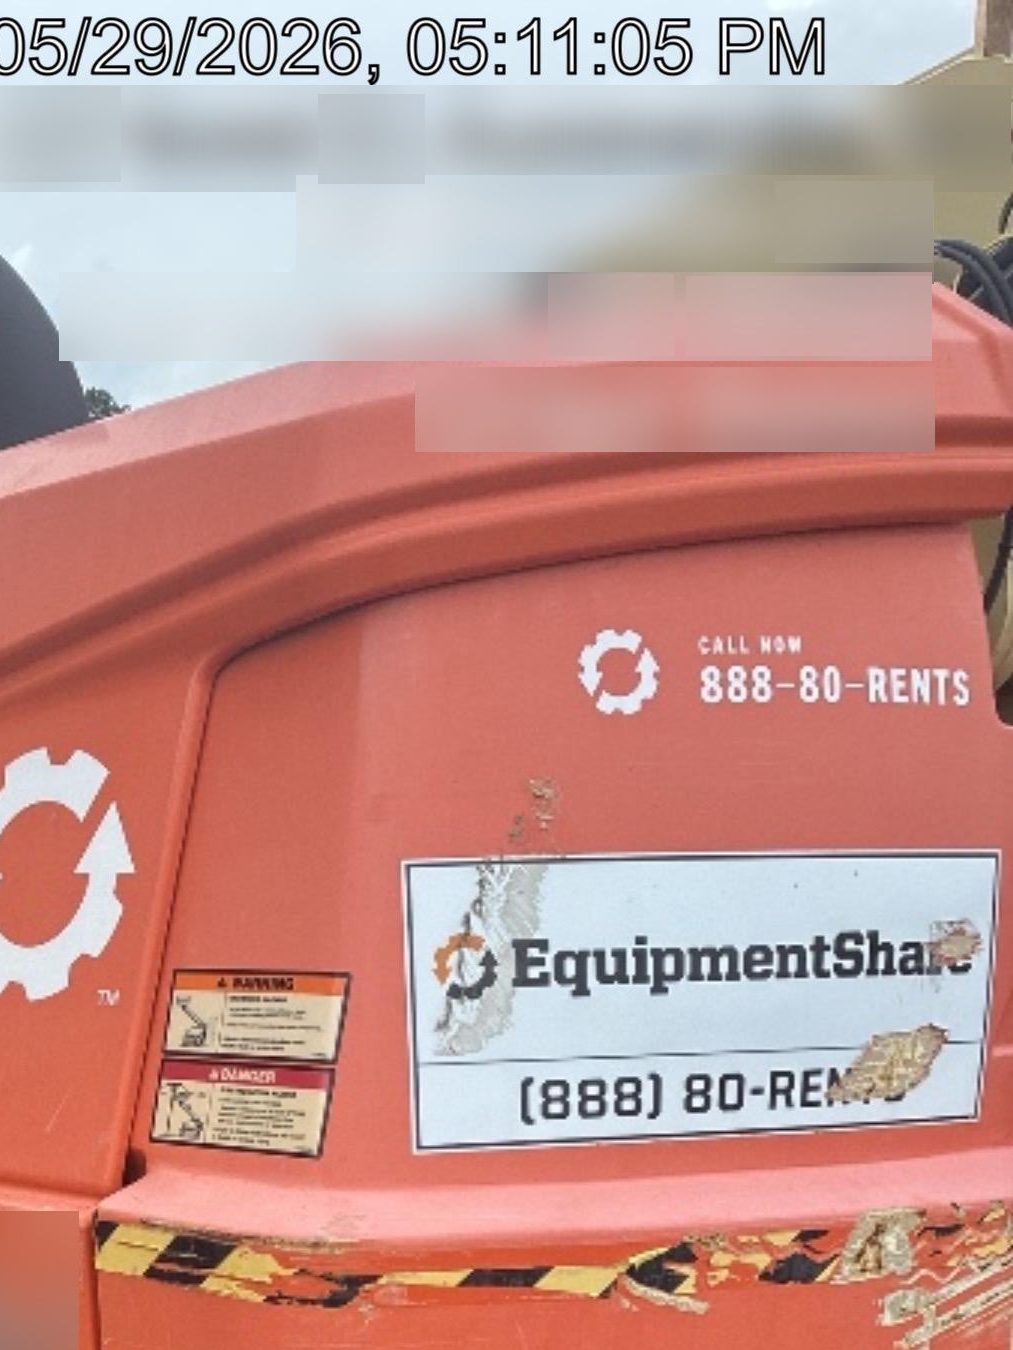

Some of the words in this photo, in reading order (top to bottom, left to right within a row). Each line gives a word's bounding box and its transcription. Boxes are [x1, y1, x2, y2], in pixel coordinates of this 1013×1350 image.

[697, 635, 751, 655] CALL
[760, 635, 803, 653] NOW
[699, 664, 970, 706] 888-80-RENTS
[519, 1072, 664, 1126] (888)
[682, 1067, 907, 1114] 80-RE
